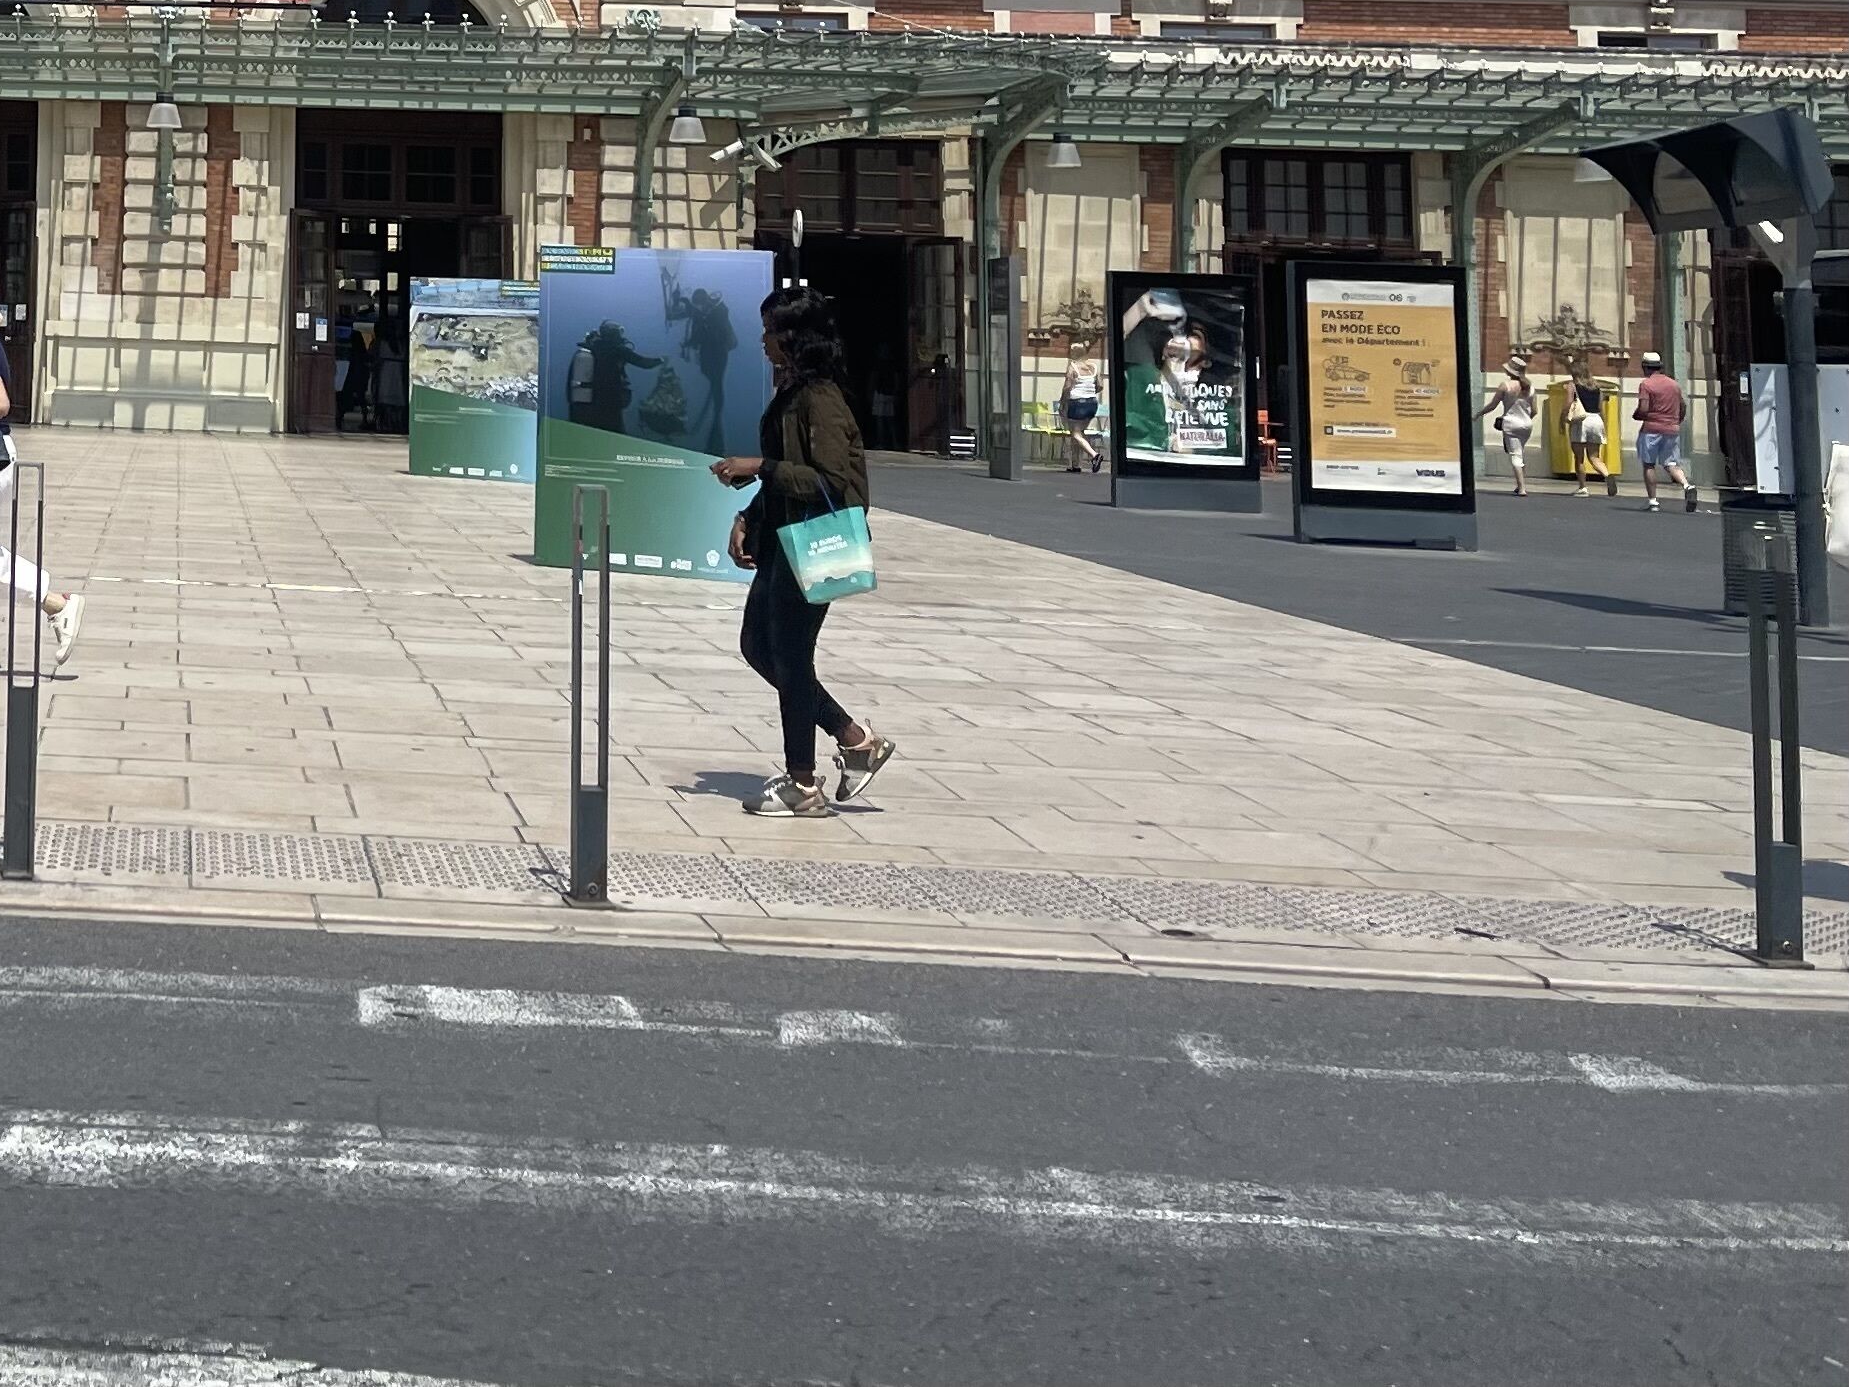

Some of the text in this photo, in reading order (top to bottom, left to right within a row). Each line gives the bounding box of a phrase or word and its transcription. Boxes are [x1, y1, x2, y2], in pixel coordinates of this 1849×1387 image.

[1321, 309, 1364, 320] PASSEZ
[1321, 323, 1337, 333] EN
[1339, 323, 1374, 335] MODE
[1196, 398, 1228, 412] SANS
[1165, 409, 1229, 427] RETENUE
